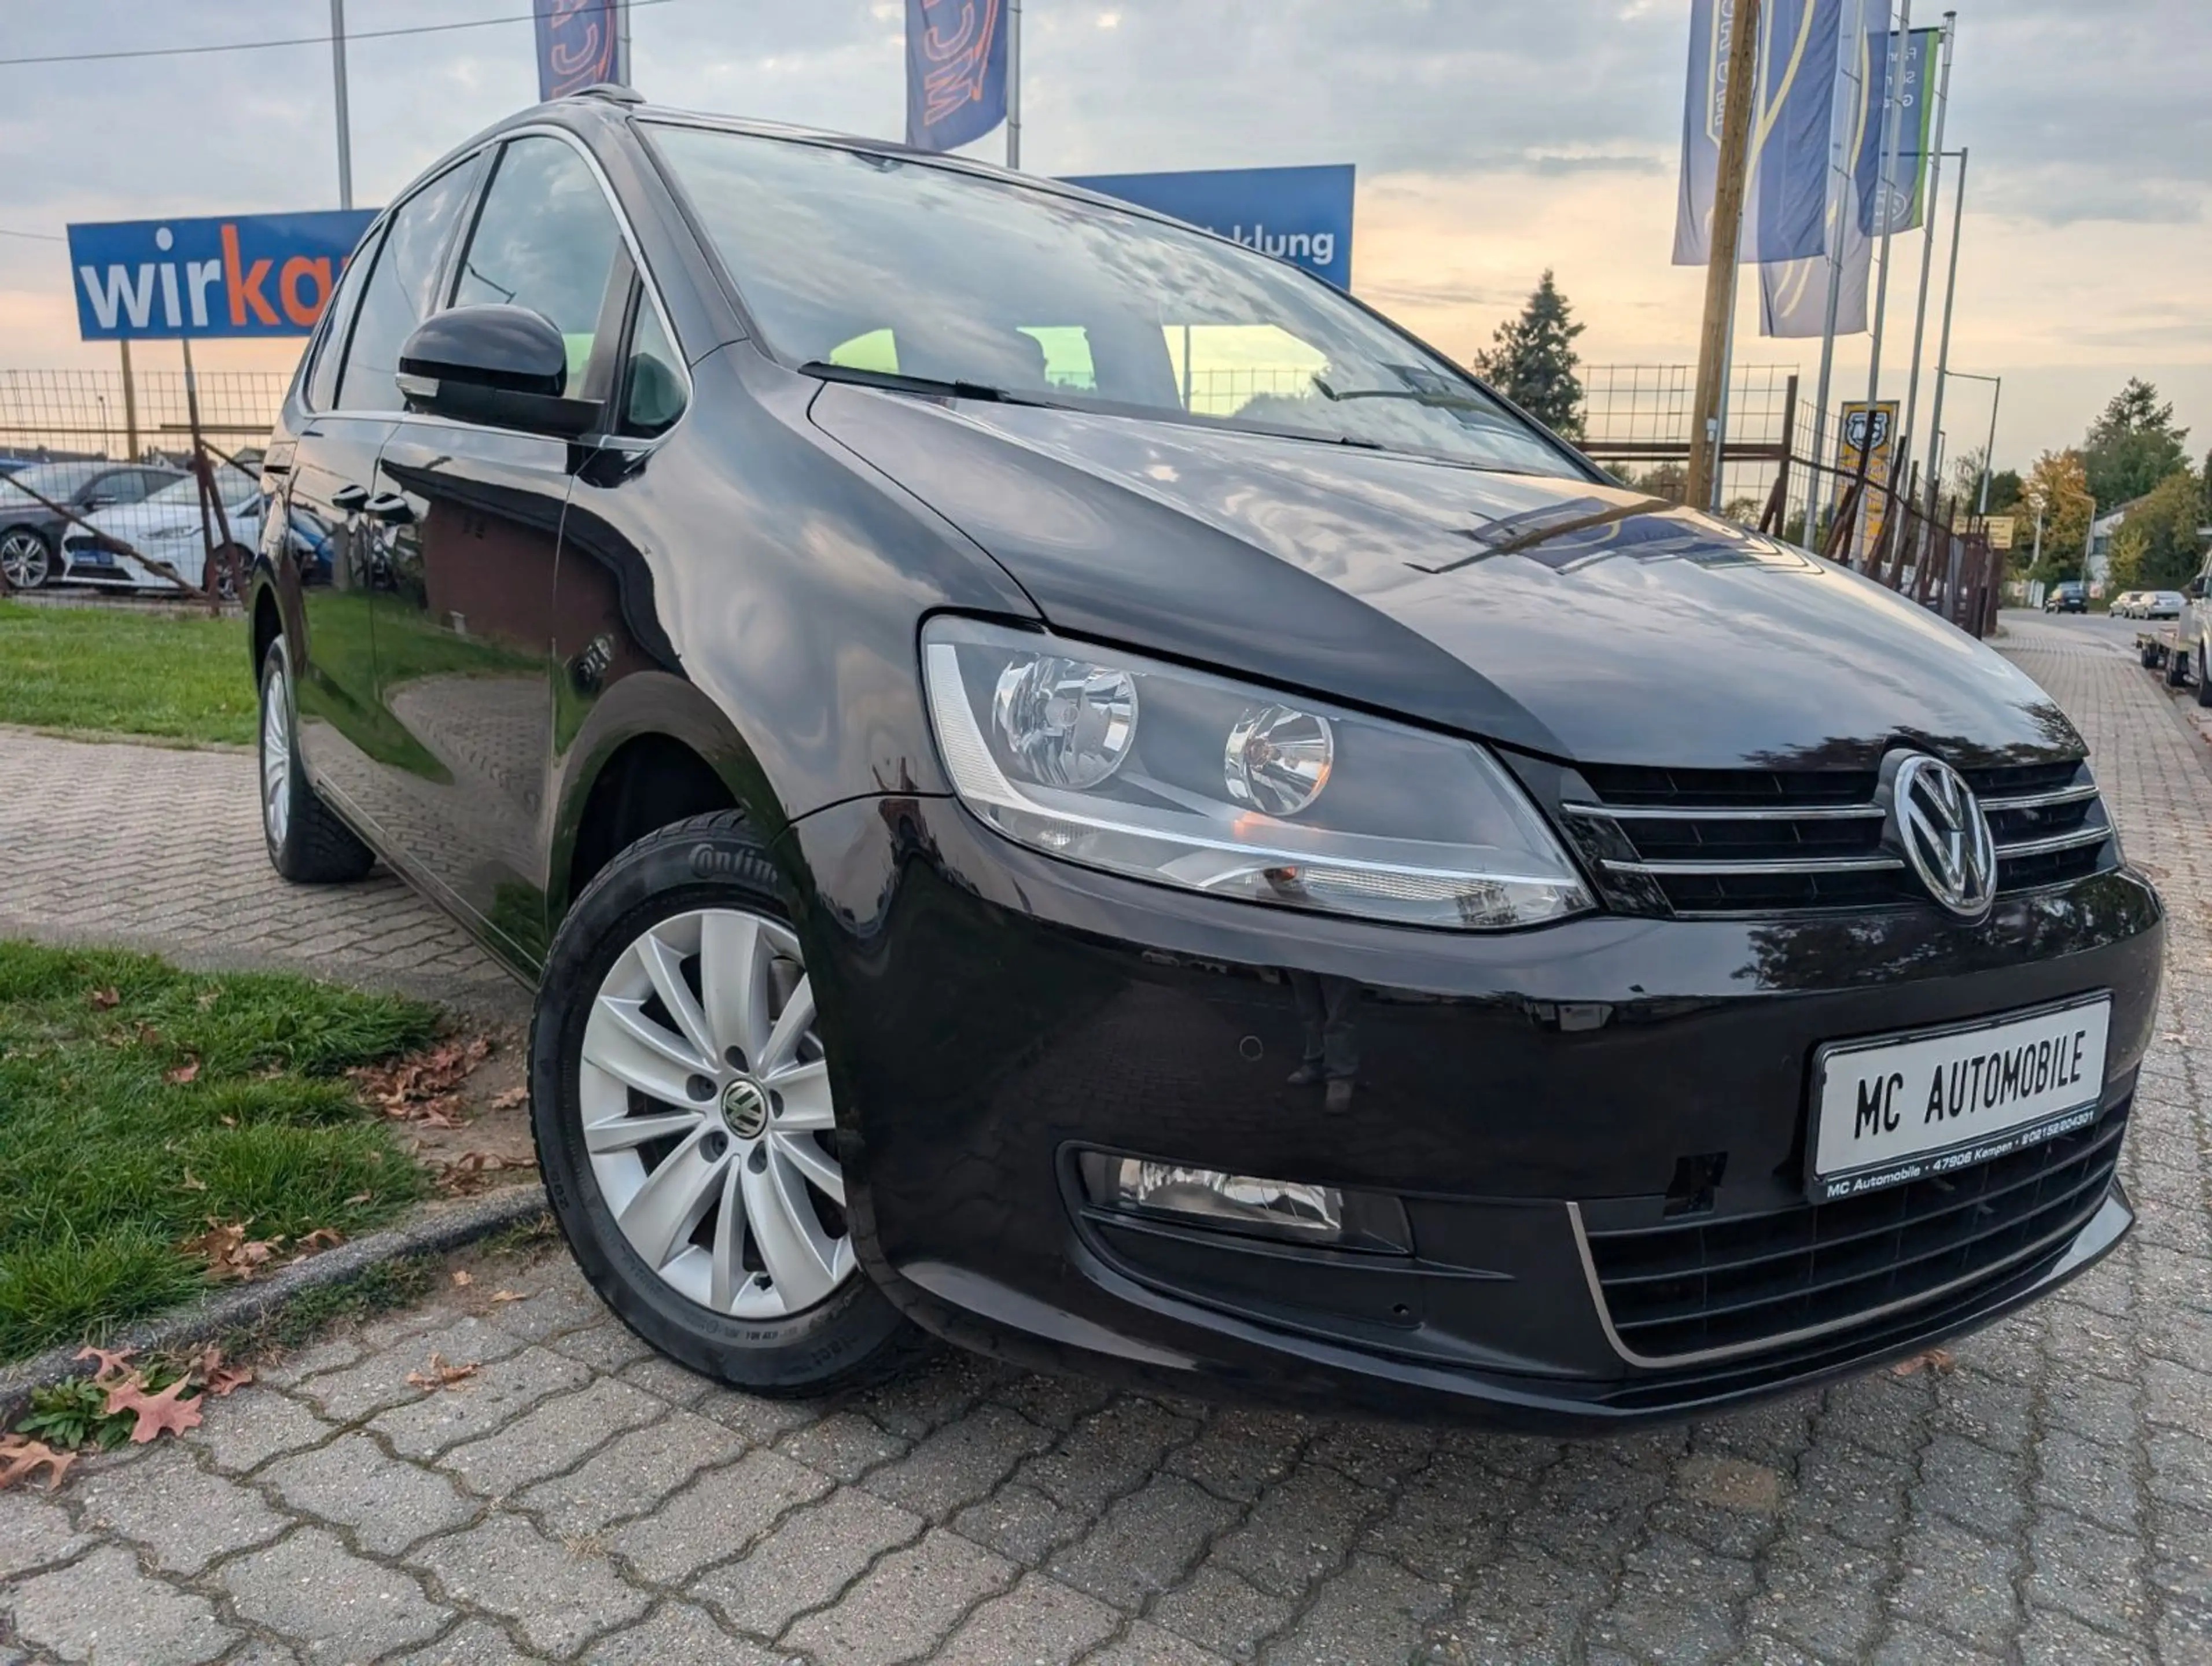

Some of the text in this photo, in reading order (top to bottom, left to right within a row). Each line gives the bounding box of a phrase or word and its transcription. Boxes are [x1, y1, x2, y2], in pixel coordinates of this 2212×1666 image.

[79, 223, 351, 327] wirka
[1854, 1030, 2085, 1139] MC AUTOMOBILE
[1827, 1181, 1850, 1197] MC
[1853, 1165, 1921, 1191] Automobile
[1933, 1152, 1973, 1171] 47906
[1974, 1142, 2014, 1160] Kempen
